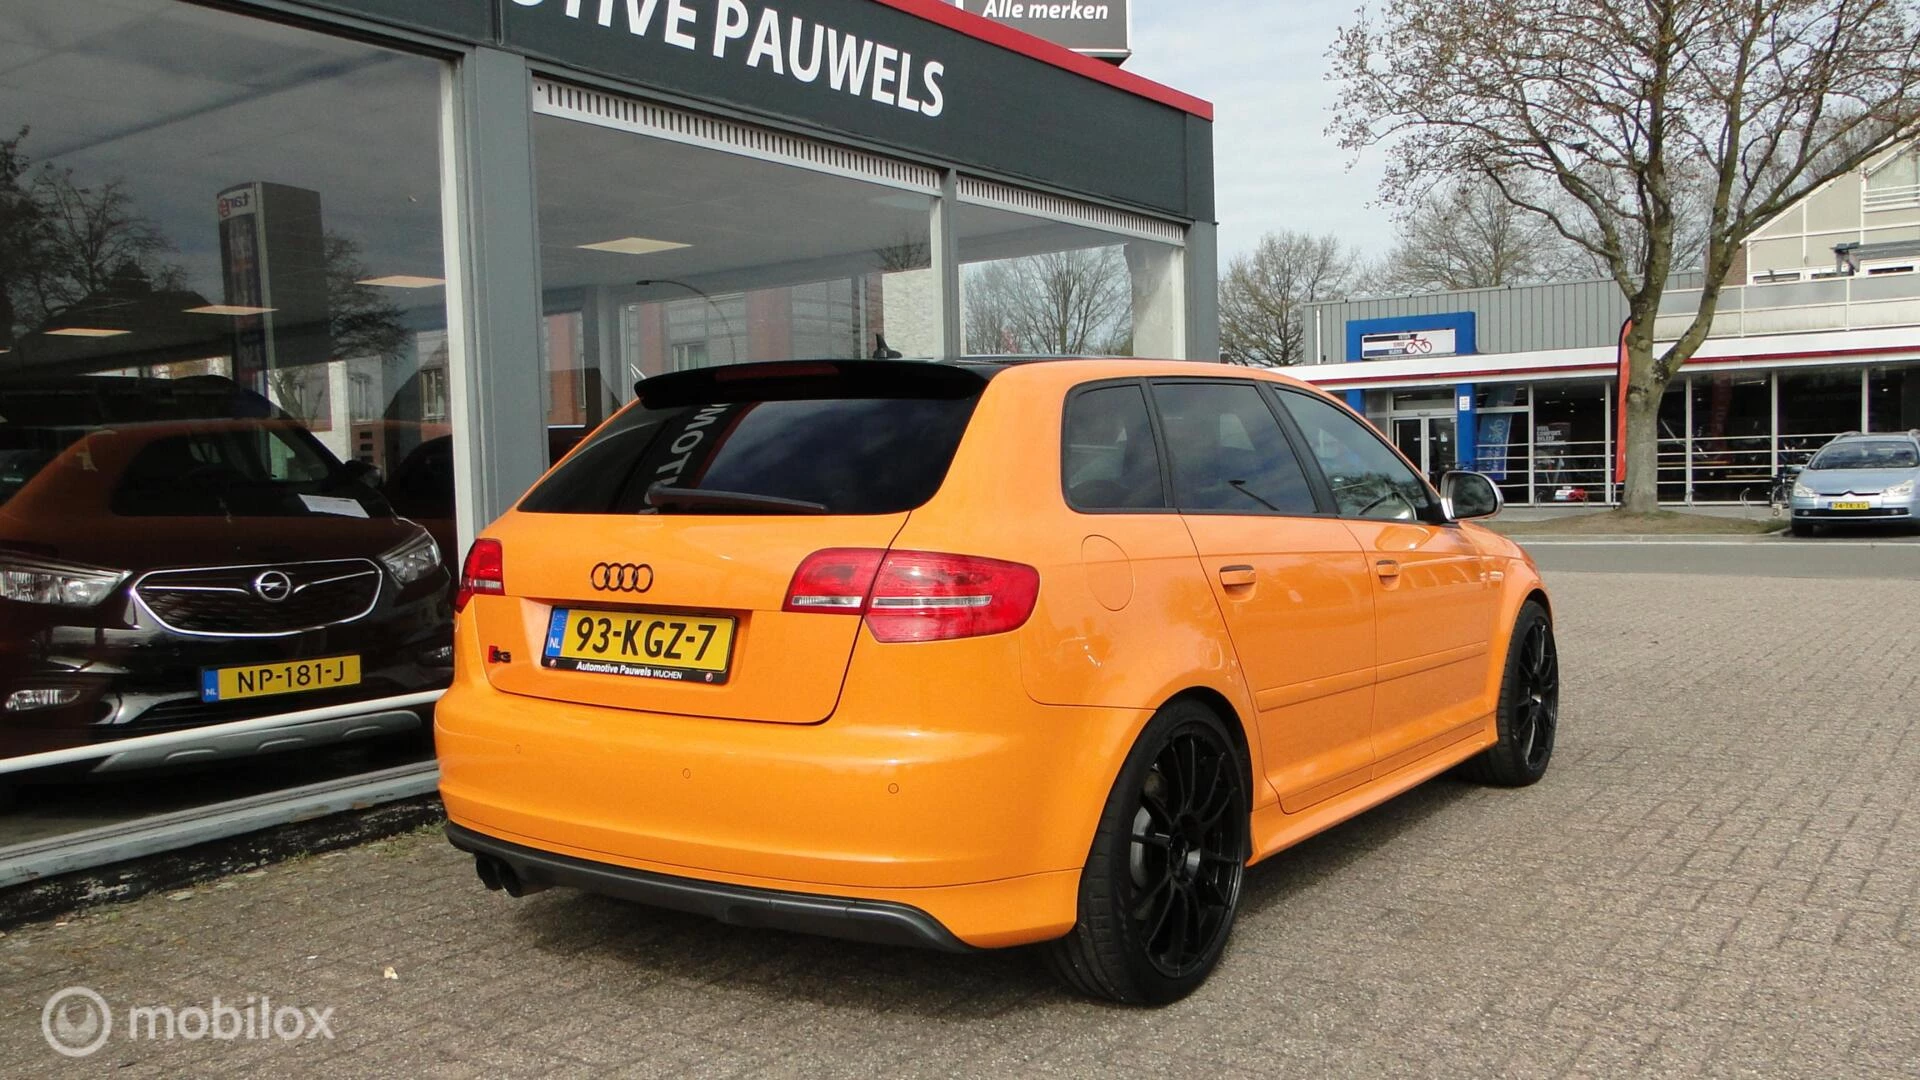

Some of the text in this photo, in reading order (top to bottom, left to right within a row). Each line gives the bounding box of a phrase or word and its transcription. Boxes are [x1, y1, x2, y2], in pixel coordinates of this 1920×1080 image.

[982, 0, 1109, 20] Alle merken
[712, 0, 945, 118] PAUWELS
[549, 616, 717, 662] NL 93-KGZ-7
[237, 661, 344, 693] NP-181-J
[576, 661, 619, 674] Automotive
[620, 664, 652, 677] Pauwels
